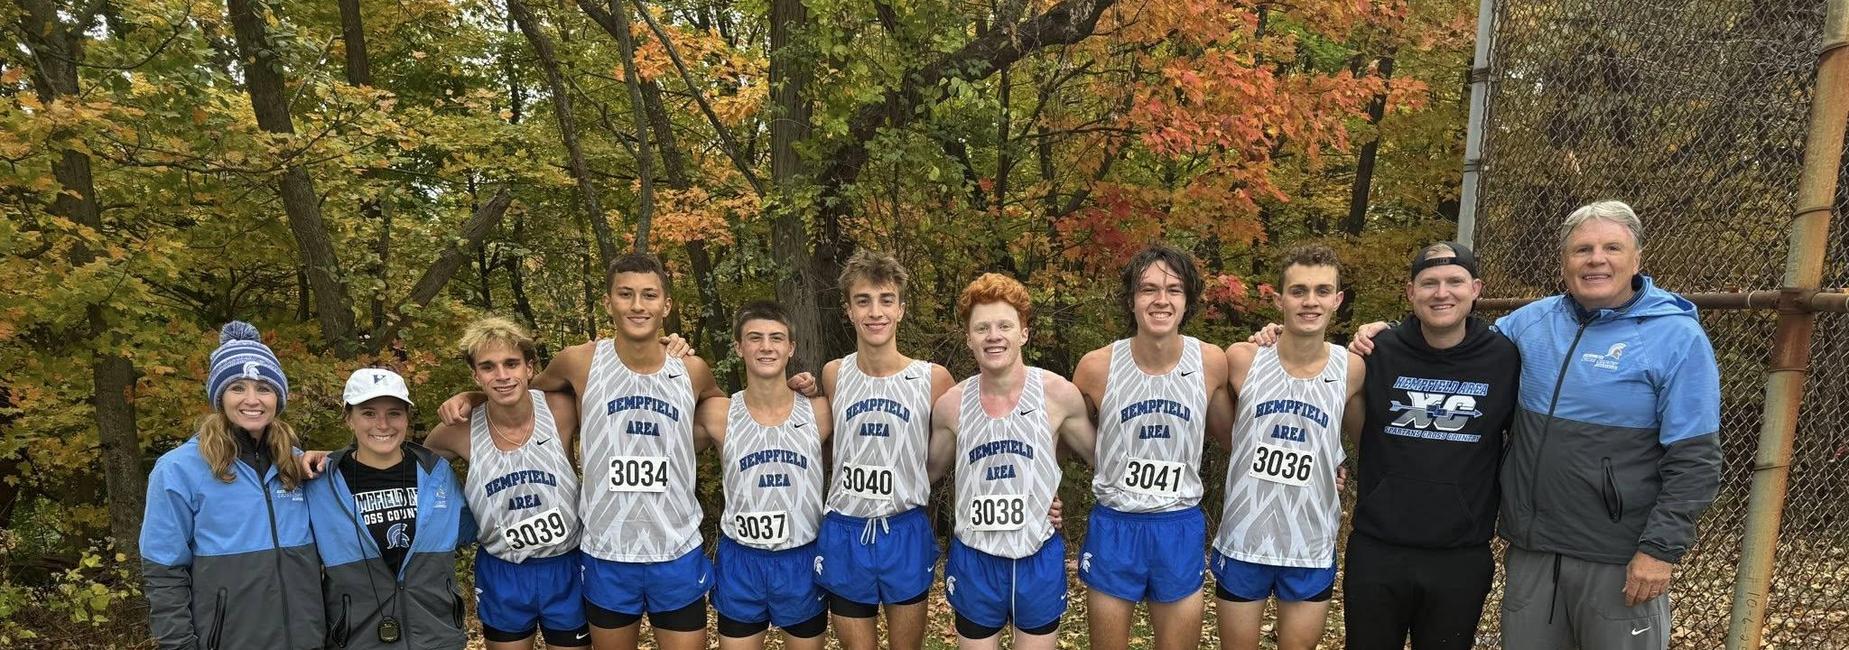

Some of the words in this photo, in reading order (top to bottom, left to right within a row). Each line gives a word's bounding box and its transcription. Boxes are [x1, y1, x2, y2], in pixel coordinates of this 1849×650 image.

[1392, 376, 1460, 394] HEMPFIELD
[1457, 382, 1489, 396] AREA
[607, 396, 679, 422] HEMPFIELD
[845, 398, 910, 424] HEMPFIELD
[1120, 399, 1190, 424] HEMPFIELD
[1254, 400, 1329, 428] HEMPFIELD
[1391, 391, 1476, 432] XC
[626, 420, 660, 436] AREA
[859, 422, 890, 438] AREA
[1138, 424, 1170, 440] AREA
[1270, 424, 1306, 442] AREA
[1384, 426, 1422, 438] SPARTANS
[1421, 430, 1448, 440] CROSS
[1446, 432, 1482, 442] COUNTRY
[739, 448, 808, 472] HEMPFIELD
[968, 440, 1034, 465] HEMPFIELD
[1252, 447, 1314, 481] 3036
[484, 469, 556, 498] HEMPFIELD
[610, 460, 668, 487] 3034
[758, 474, 791, 488] AREA
[842, 466, 893, 495] 3040
[985, 464, 1016, 480] AREA
[1125, 461, 1184, 492] 3041
[353, 488, 408, 514] MPFIELD
[407, 487, 418, 506] A
[508, 494, 542, 510] AREA
[971, 498, 1024, 526] 3038
[363, 511, 384, 526] OSS
[735, 514, 786, 541] 3037
[506, 512, 566, 551] 3039
